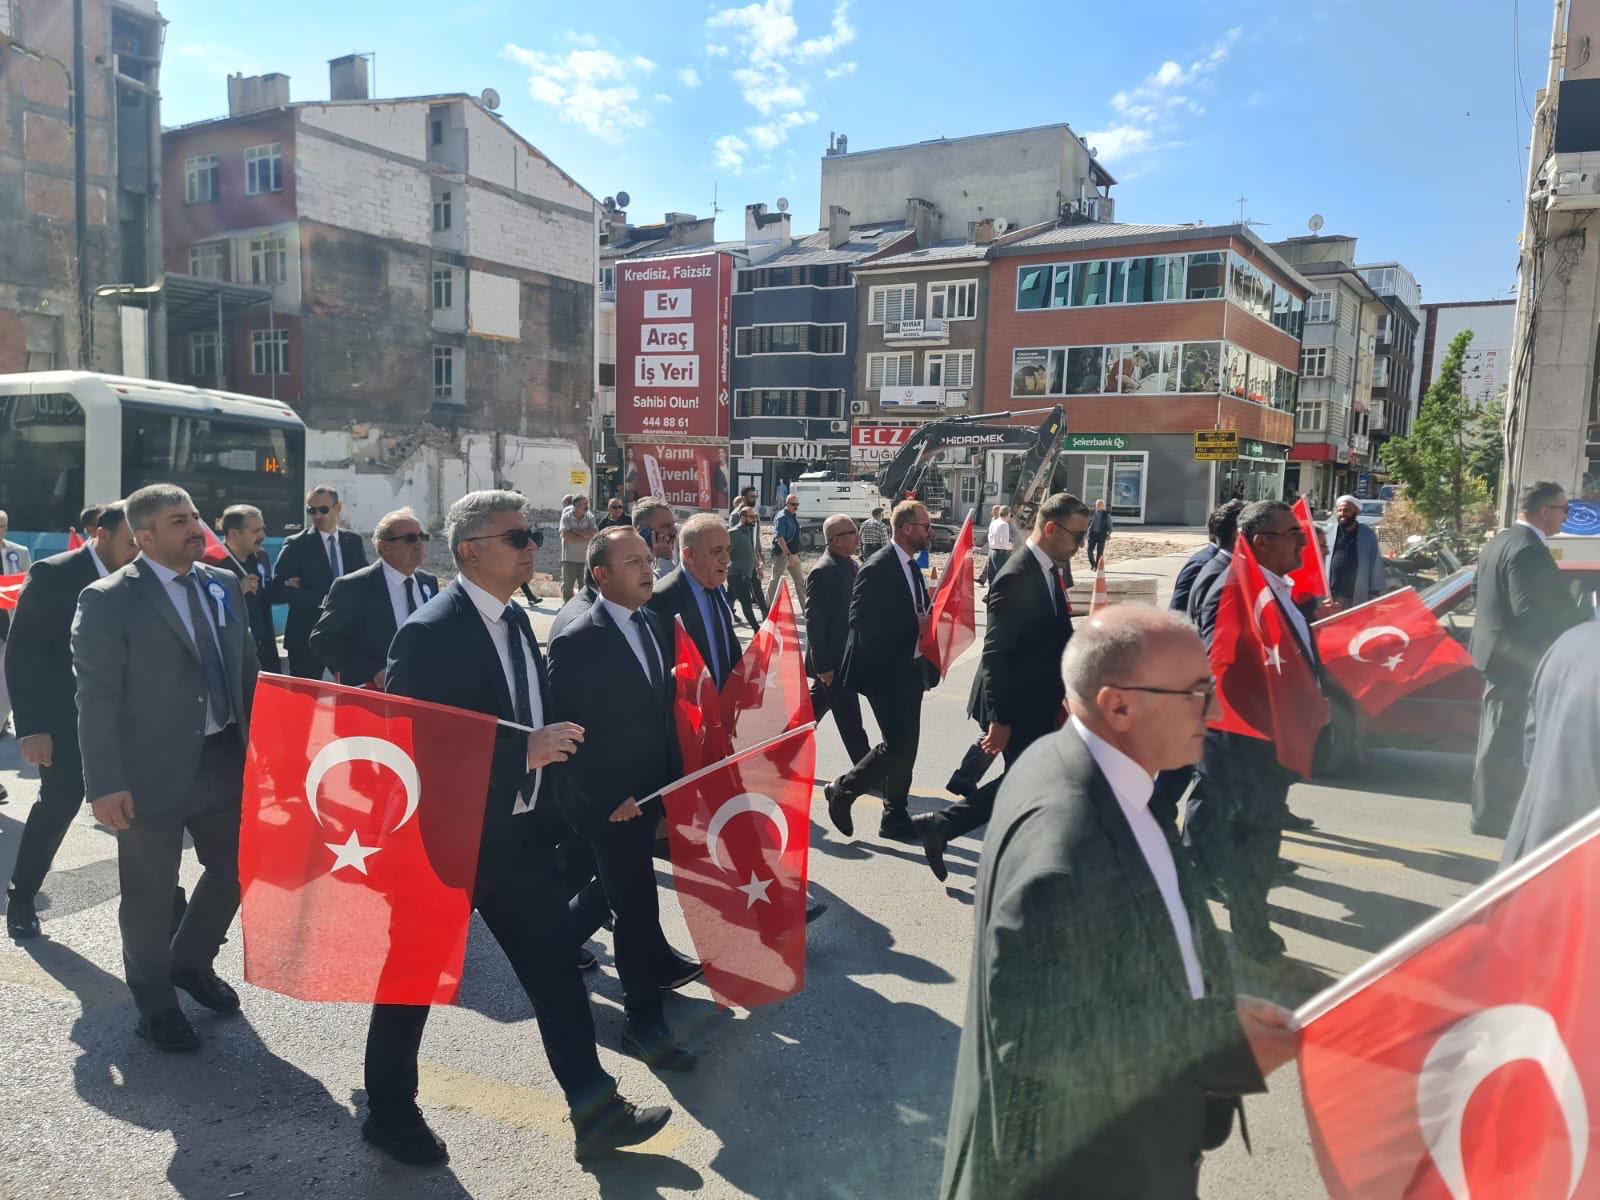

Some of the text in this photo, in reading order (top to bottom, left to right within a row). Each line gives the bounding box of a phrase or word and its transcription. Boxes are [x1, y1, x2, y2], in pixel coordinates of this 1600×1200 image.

[624, 264, 712, 282] Kredisiz, Faizsiz
[657, 293, 678, 311] Ev
[646, 328, 688, 350] Araç
[641, 358, 693, 385] İş Yeri
[633, 396, 699, 409] Sahibi Olun!
[642, 416, 689, 428] 444 88 61
[1072, 437, 1113, 447] Şekerbank
[656, 445, 694, 459] Yarını
[777, 443, 827, 460] COOL
[660, 467, 700, 480] üvenle
